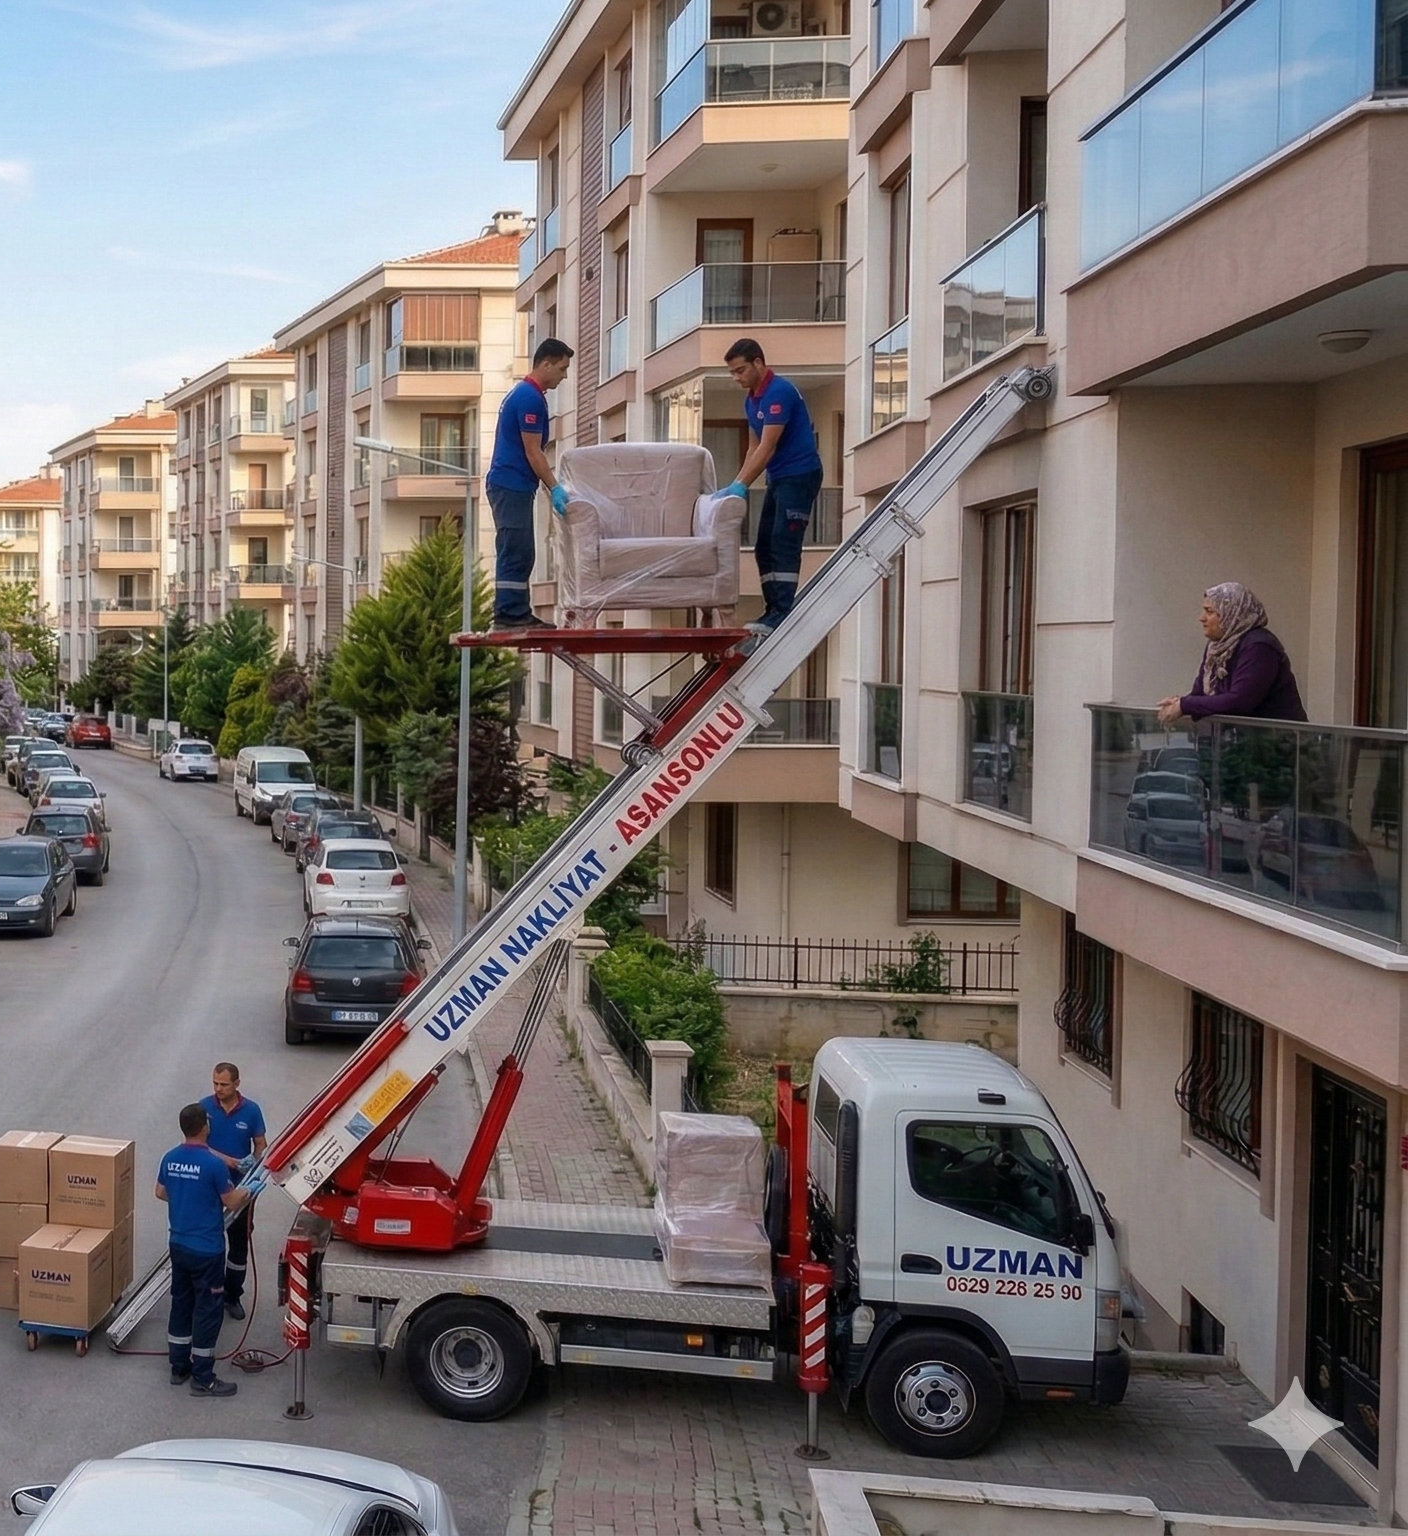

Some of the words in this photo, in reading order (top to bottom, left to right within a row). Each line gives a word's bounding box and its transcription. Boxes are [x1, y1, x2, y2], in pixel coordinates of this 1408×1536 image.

[423, 957, 509, 1041] UZMAN
[499, 849, 607, 964] NAKLİYAT
[615, 702, 745, 845] ASANSONLU
[946, 1245, 1083, 1279] UZMAN
[31, 1269, 71, 1282] UZMAN
[1033, 1282, 1055, 1299] 25
[1061, 1284, 1082, 1300] 90
